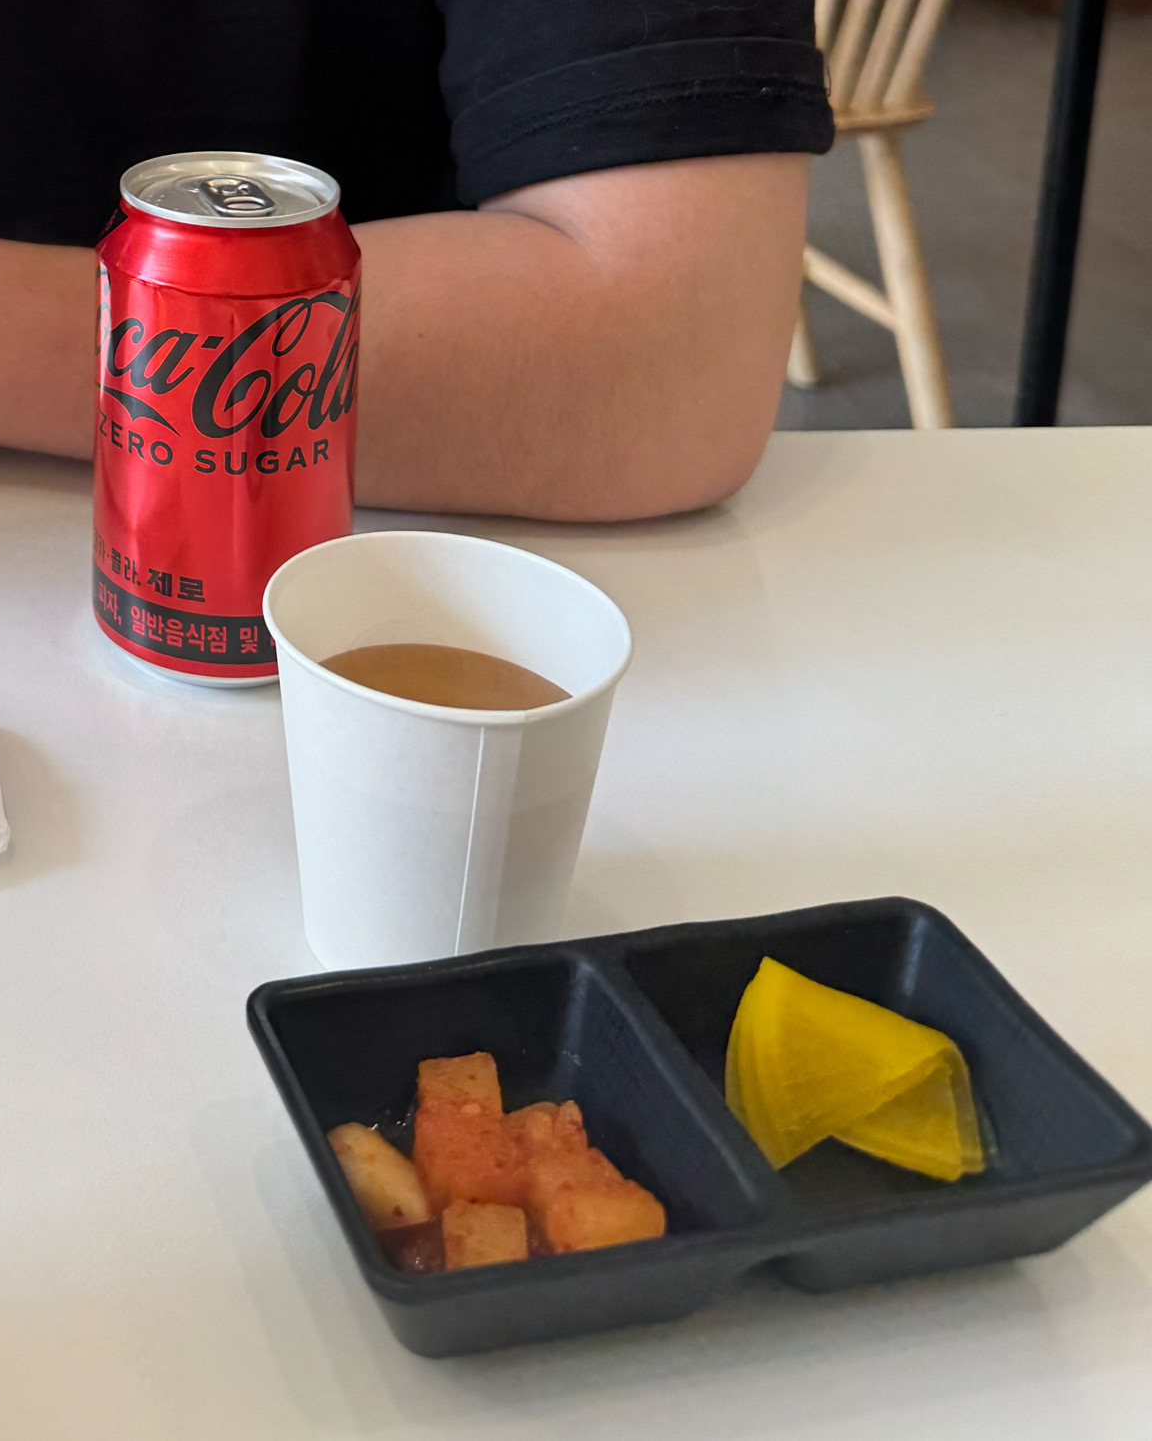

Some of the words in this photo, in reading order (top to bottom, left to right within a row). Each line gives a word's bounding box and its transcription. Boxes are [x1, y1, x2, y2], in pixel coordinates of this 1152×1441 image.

[95, 278, 359, 439] oca-Cola
[99, 411, 174, 466] ZERO
[194, 438, 330, 476] SUGAR
[146, 567, 206, 603] 제로
[130, 604, 227, 654] 일반음식점
[239, 625, 258, 654] 및
